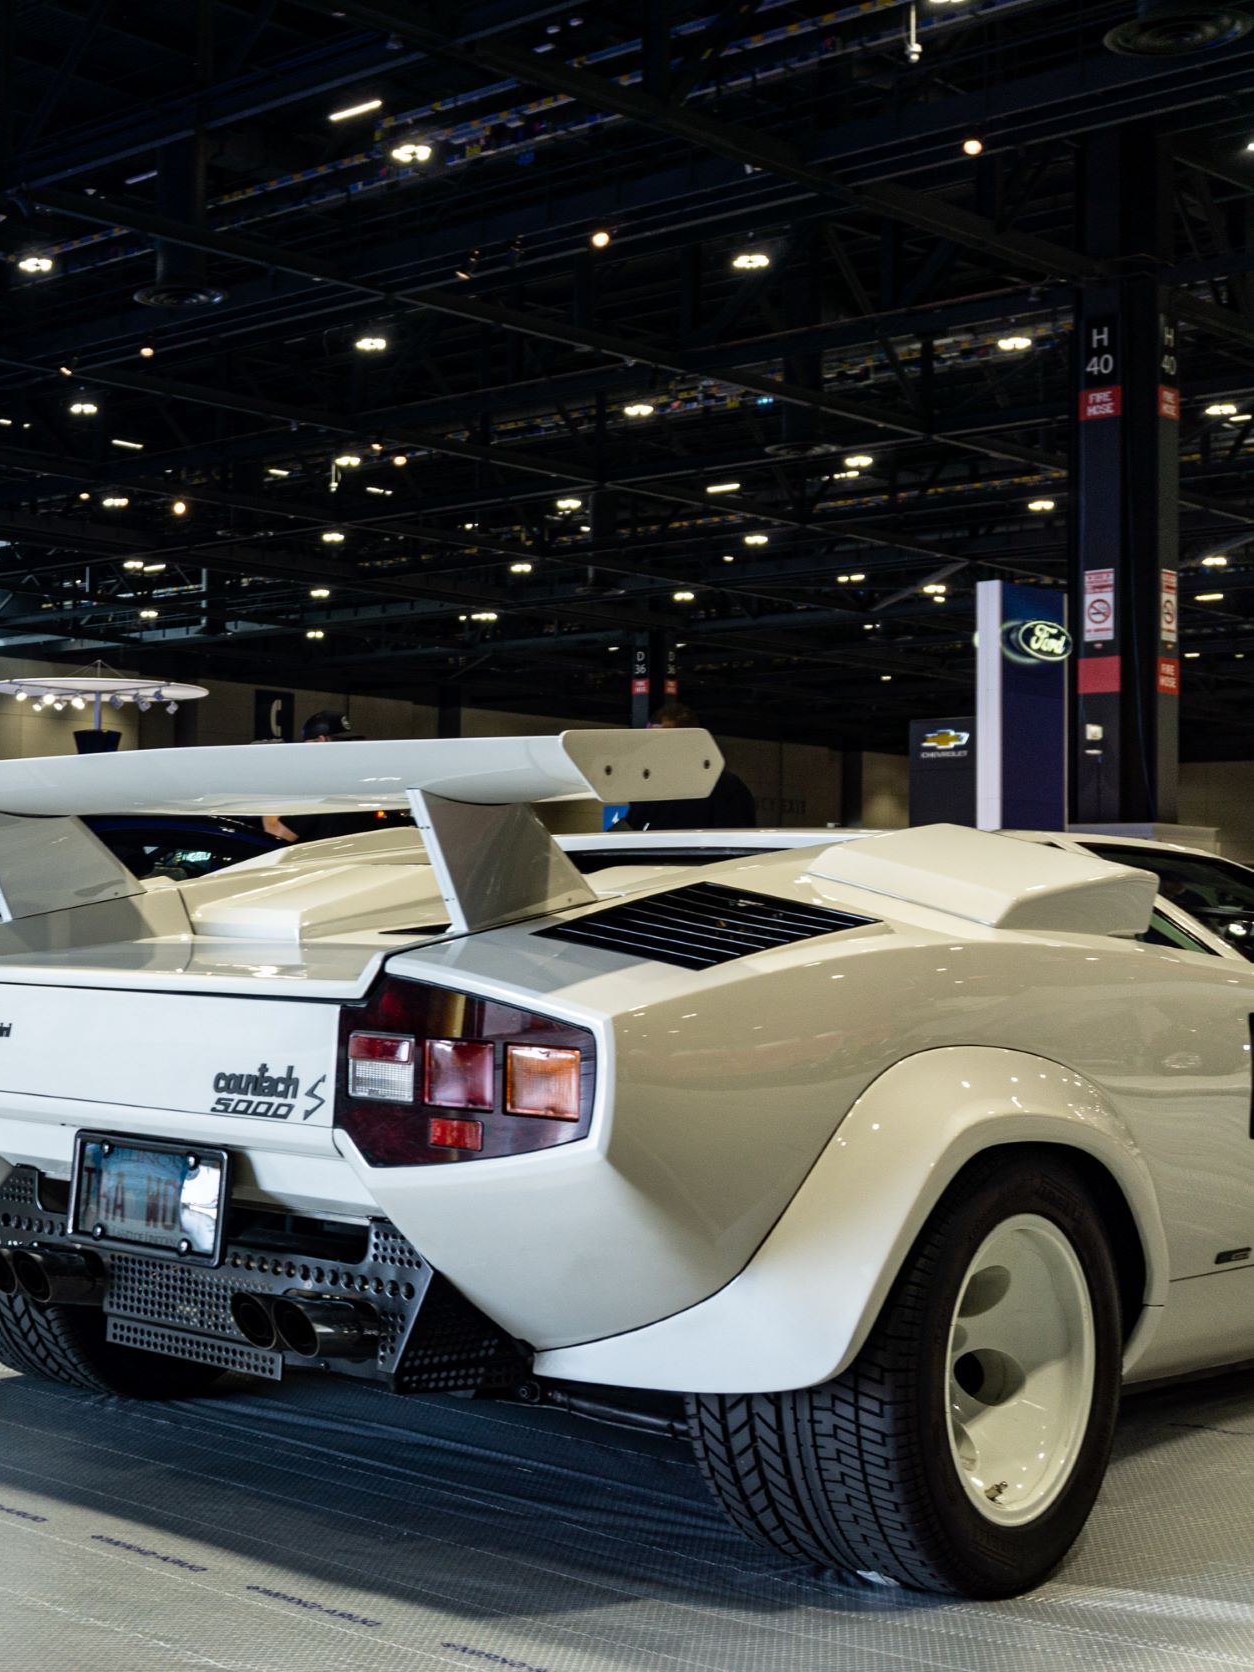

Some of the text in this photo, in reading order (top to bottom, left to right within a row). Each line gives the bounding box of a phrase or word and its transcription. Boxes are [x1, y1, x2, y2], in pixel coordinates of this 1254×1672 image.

[1091, 326, 1108, 348] H
[1164, 326, 1174, 348] H
[1086, 353, 1114, 375] 40
[1088, 391, 1113, 404] FIRE
[1087, 402, 1115, 416] HOSE
[1029, 623, 1066, 655] Ford
[636, 651, 646, 662] D
[920, 750, 969, 760] CHEVROLET
[213, 1062, 299, 1100] countach
[210, 1073, 327, 1121] 5000 S
